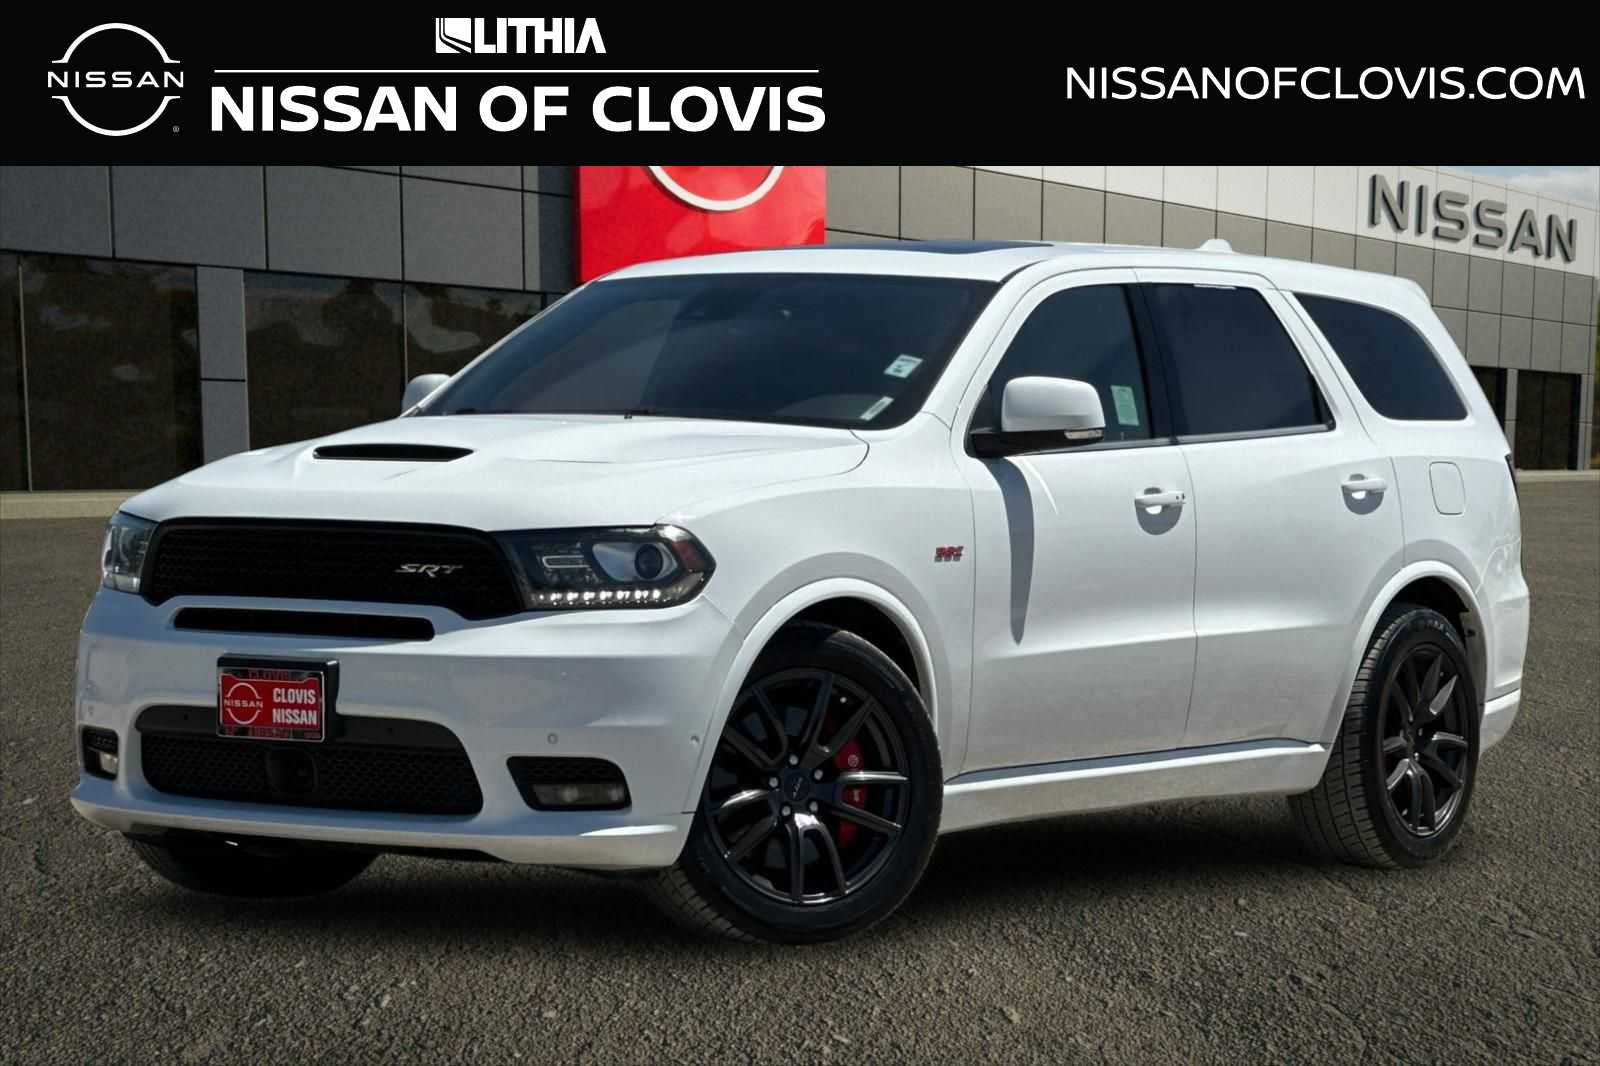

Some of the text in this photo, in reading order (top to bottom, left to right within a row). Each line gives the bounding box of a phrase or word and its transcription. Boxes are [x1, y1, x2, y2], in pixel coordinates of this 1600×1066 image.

[1369, 174, 1577, 263] NISSAN
[395, 563, 463, 578] SRT
[224, 699, 263, 708] NISSAN
[273, 688, 316, 704] CLOVIS
[272, 708, 317, 725] NISSAN
